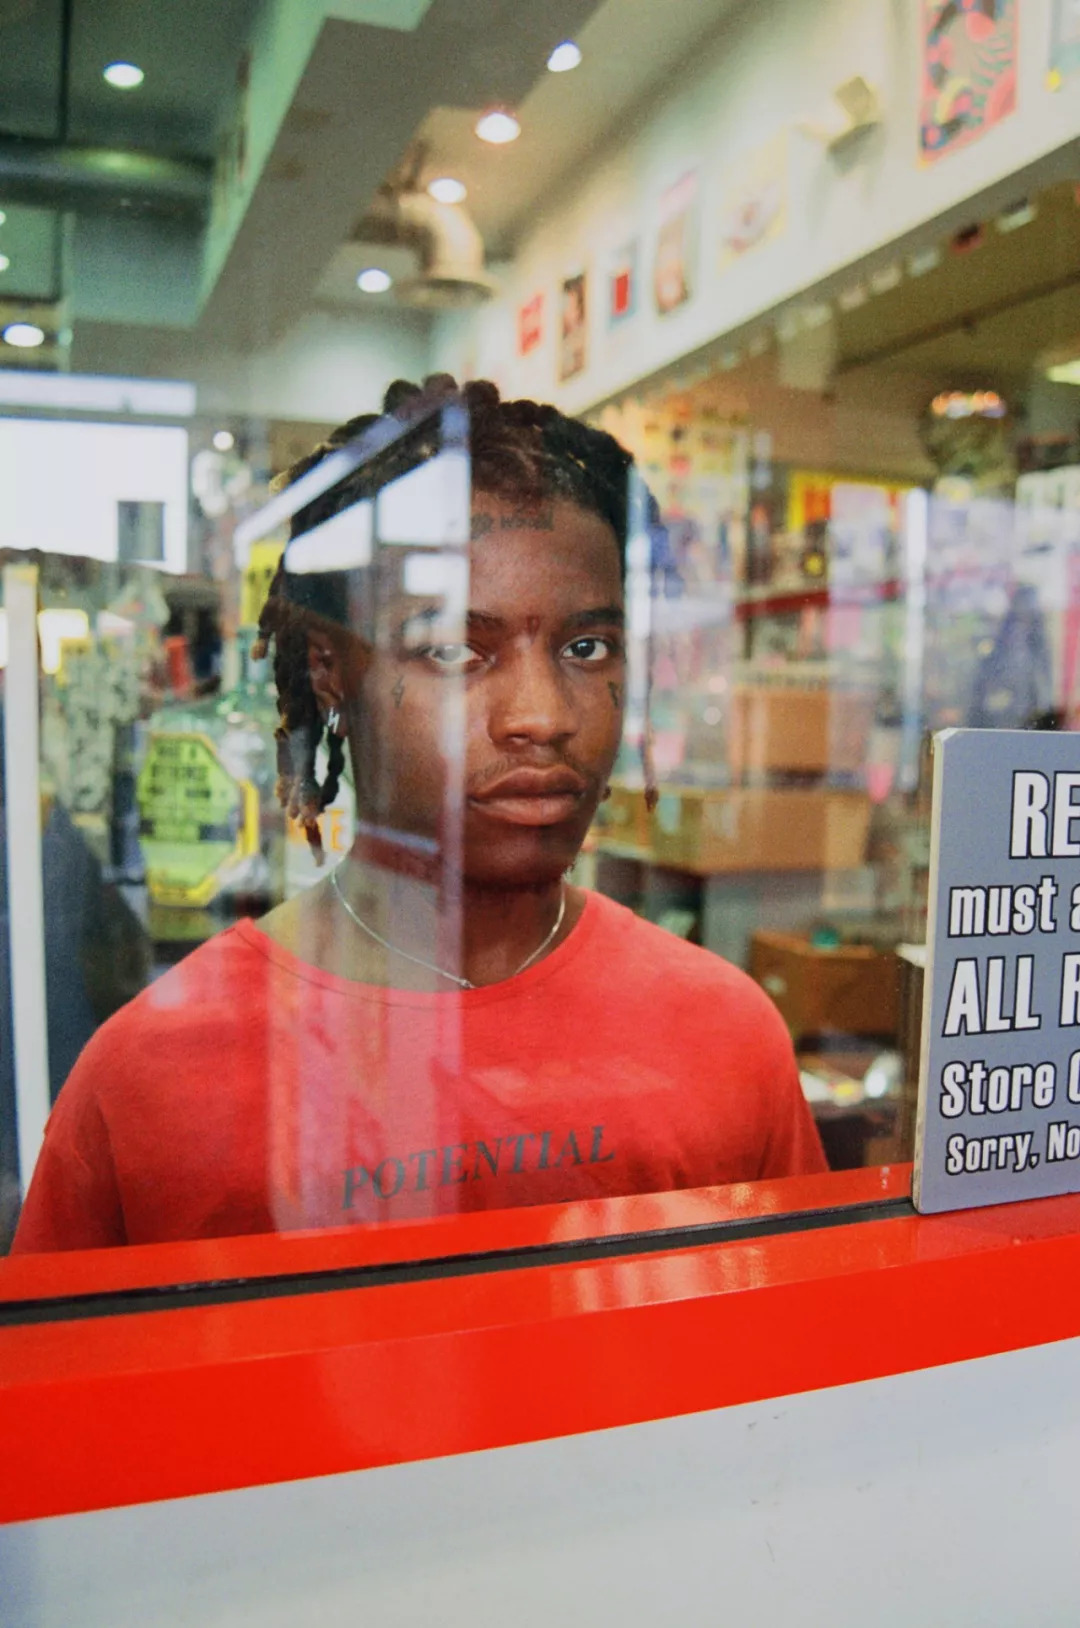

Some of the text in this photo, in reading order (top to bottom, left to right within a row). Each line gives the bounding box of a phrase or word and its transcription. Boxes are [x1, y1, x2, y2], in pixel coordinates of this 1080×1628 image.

[1008, 770, 1080, 859] RE
[947, 875, 1058, 938] must
[941, 954, 1041, 1037] ALL
[940, 1060, 1056, 1119] Store
[340, 1124, 615, 1210] POTENTIAL
[945, 1120, 1080, 1175] Sorry, No
